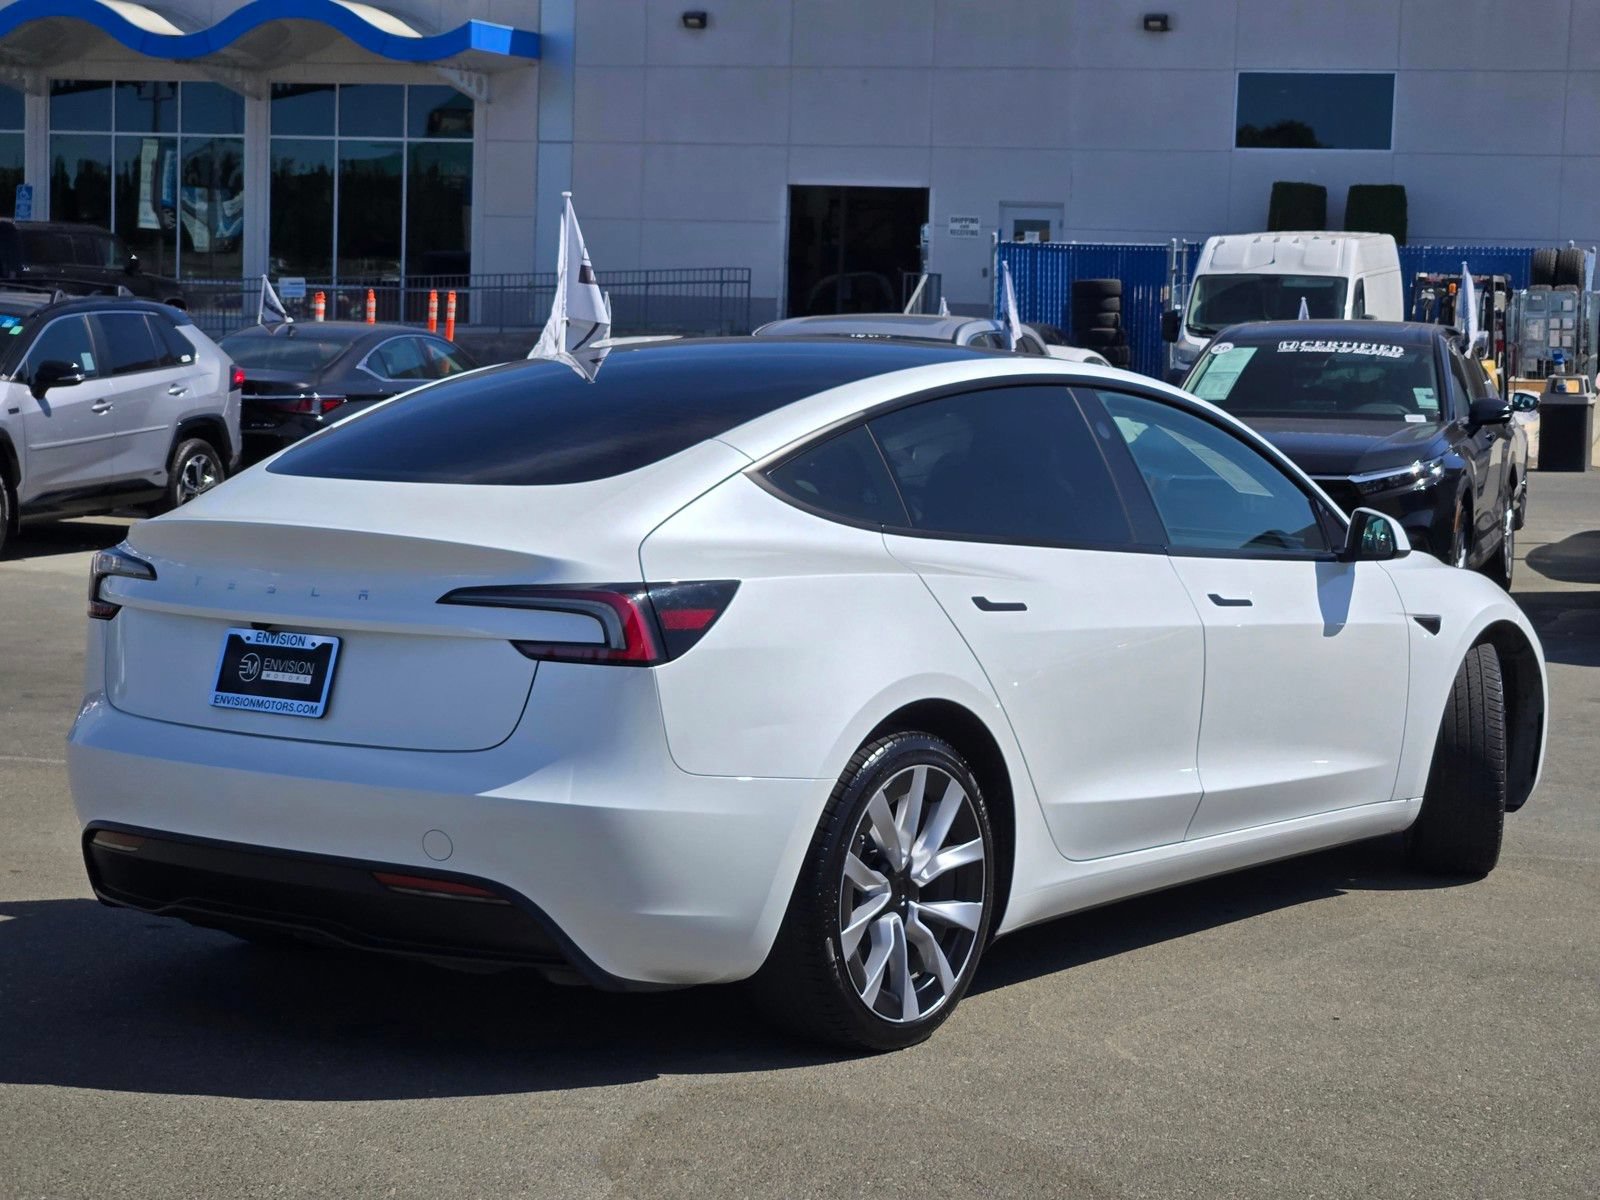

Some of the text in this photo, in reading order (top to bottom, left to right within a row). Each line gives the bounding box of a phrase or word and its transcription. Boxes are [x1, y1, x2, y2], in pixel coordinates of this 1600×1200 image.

[1300, 340, 1404, 353] CERTIFIED
[255, 631, 307, 647] ENVISION
[263, 657, 315, 674] ENVISION
[265, 671, 309, 683] MOTORS
[213, 694, 318, 715] ENVISIONMOTORS.COM
